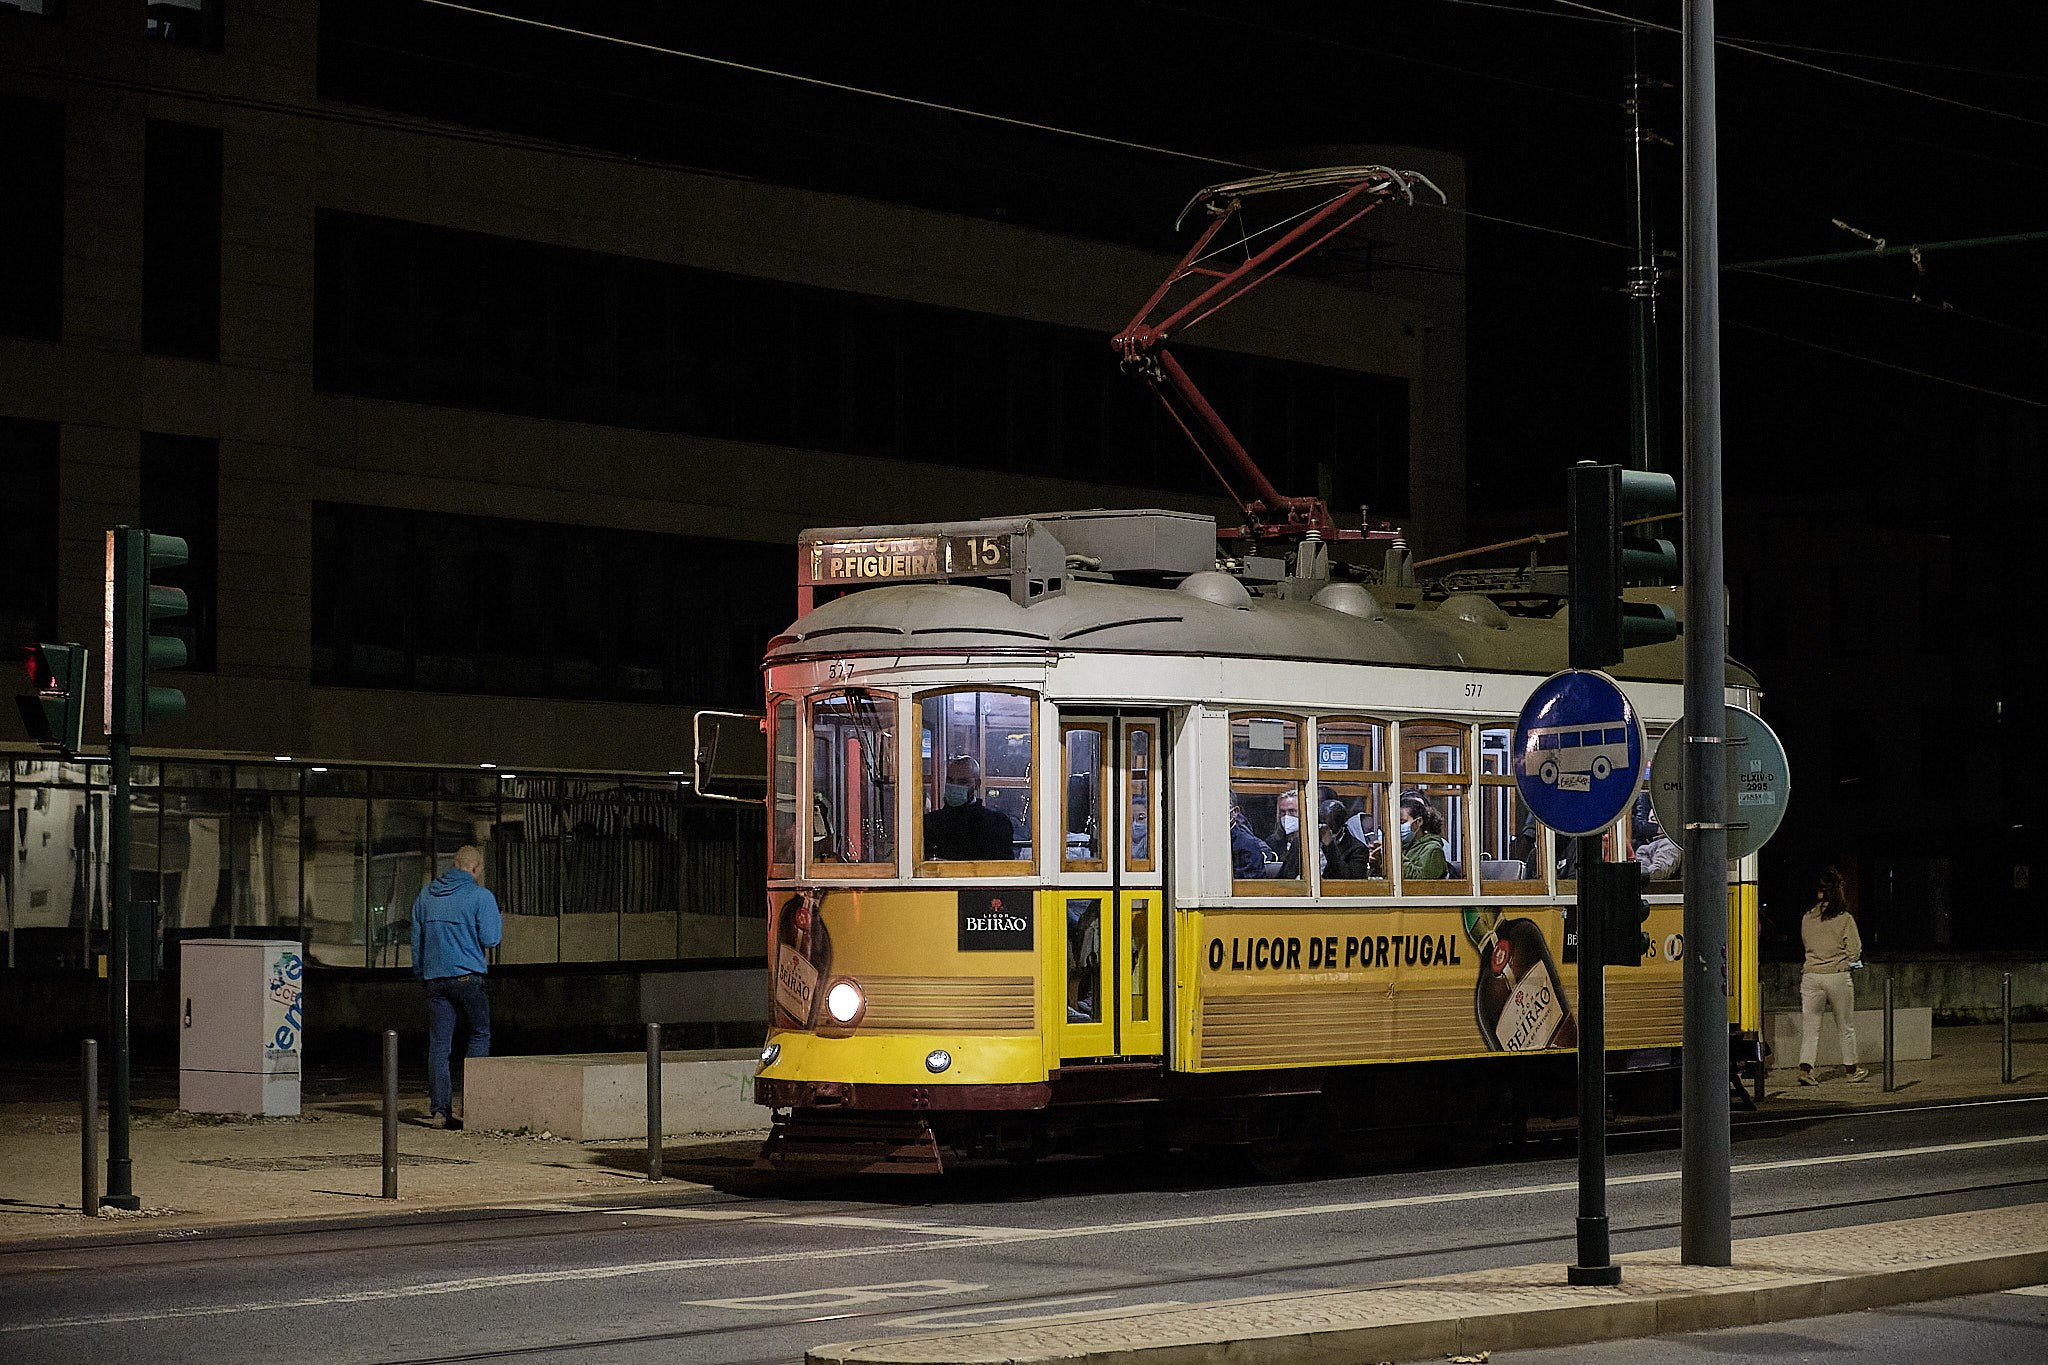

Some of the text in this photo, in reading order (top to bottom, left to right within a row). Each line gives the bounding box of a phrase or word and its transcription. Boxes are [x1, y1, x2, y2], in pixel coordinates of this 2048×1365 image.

[967, 537, 1001, 566] 15
[830, 554, 937, 578] P.FIGUEIRA
[829, 663, 855, 679] 577
[1464, 683, 1483, 698] 577
[966, 916, 1027, 931] BEIRÃO
[1208, 934, 1461, 971] O LICOR DE PORTUGAL
[779, 964, 810, 1001] BEIRÃO
[1506, 986, 1551, 1052] BEIRÃO
